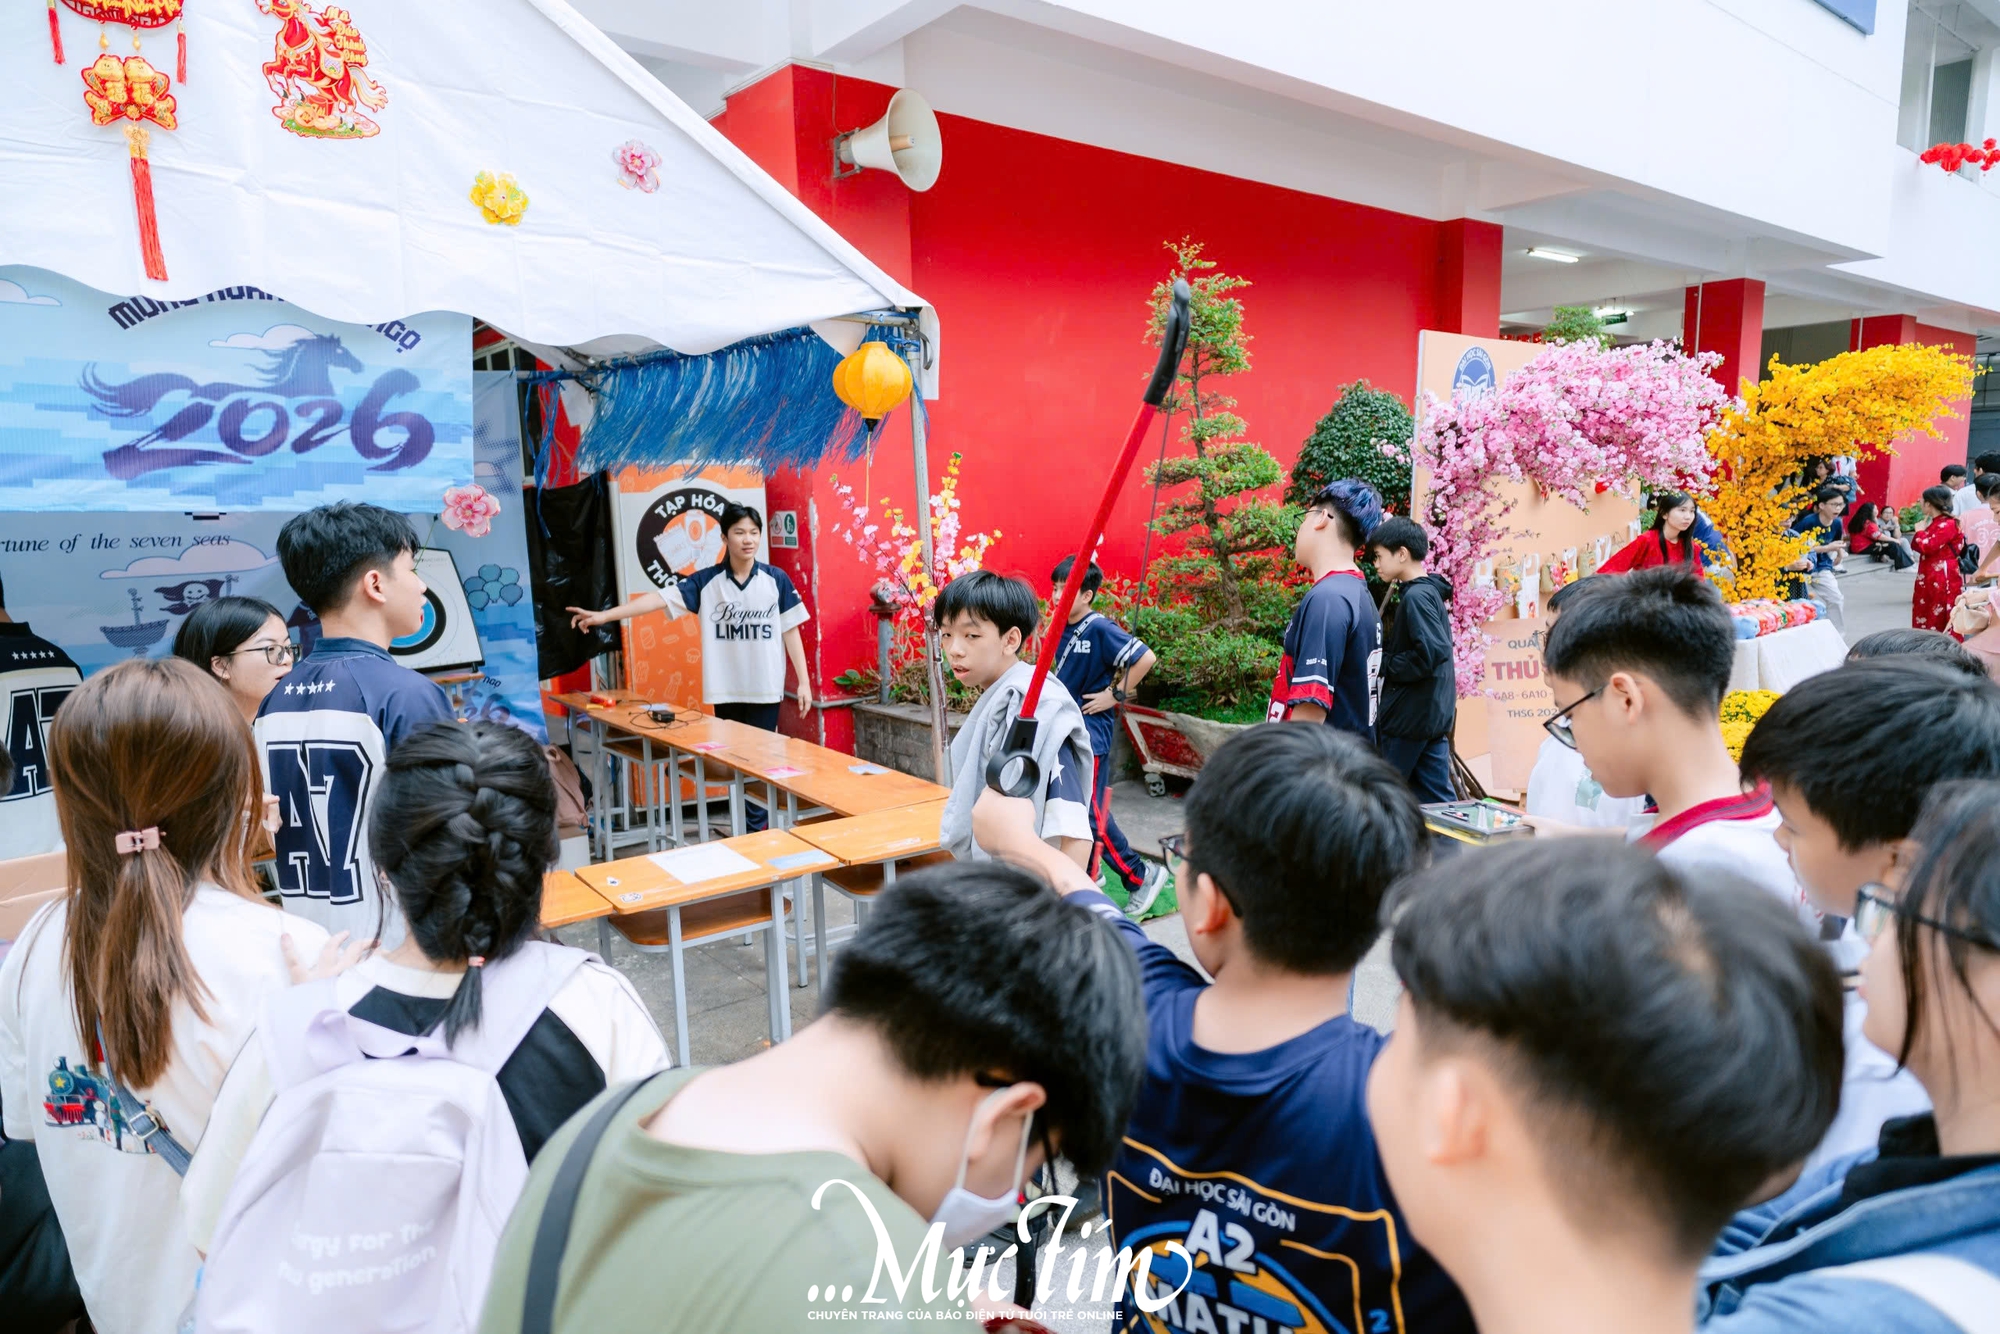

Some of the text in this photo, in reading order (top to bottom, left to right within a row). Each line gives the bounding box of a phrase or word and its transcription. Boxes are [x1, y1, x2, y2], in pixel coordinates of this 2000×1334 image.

[103, 368, 435, 480] 2026
[655, 493, 725, 518] TẠP HÓA
[0, 533, 230, 554] tune of the seven seas
[647, 559, 688, 587] THÔ
[710, 601, 777, 624] Beyond
[716, 623, 772, 640] LIMITS
[1491, 654, 1540, 681] THỦ
[266, 739, 374, 905] A7
[1150, 1167, 1296, 1232] ĐẠI HỌC SÀI GÒN
[1184, 1208, 1257, 1275] A2
